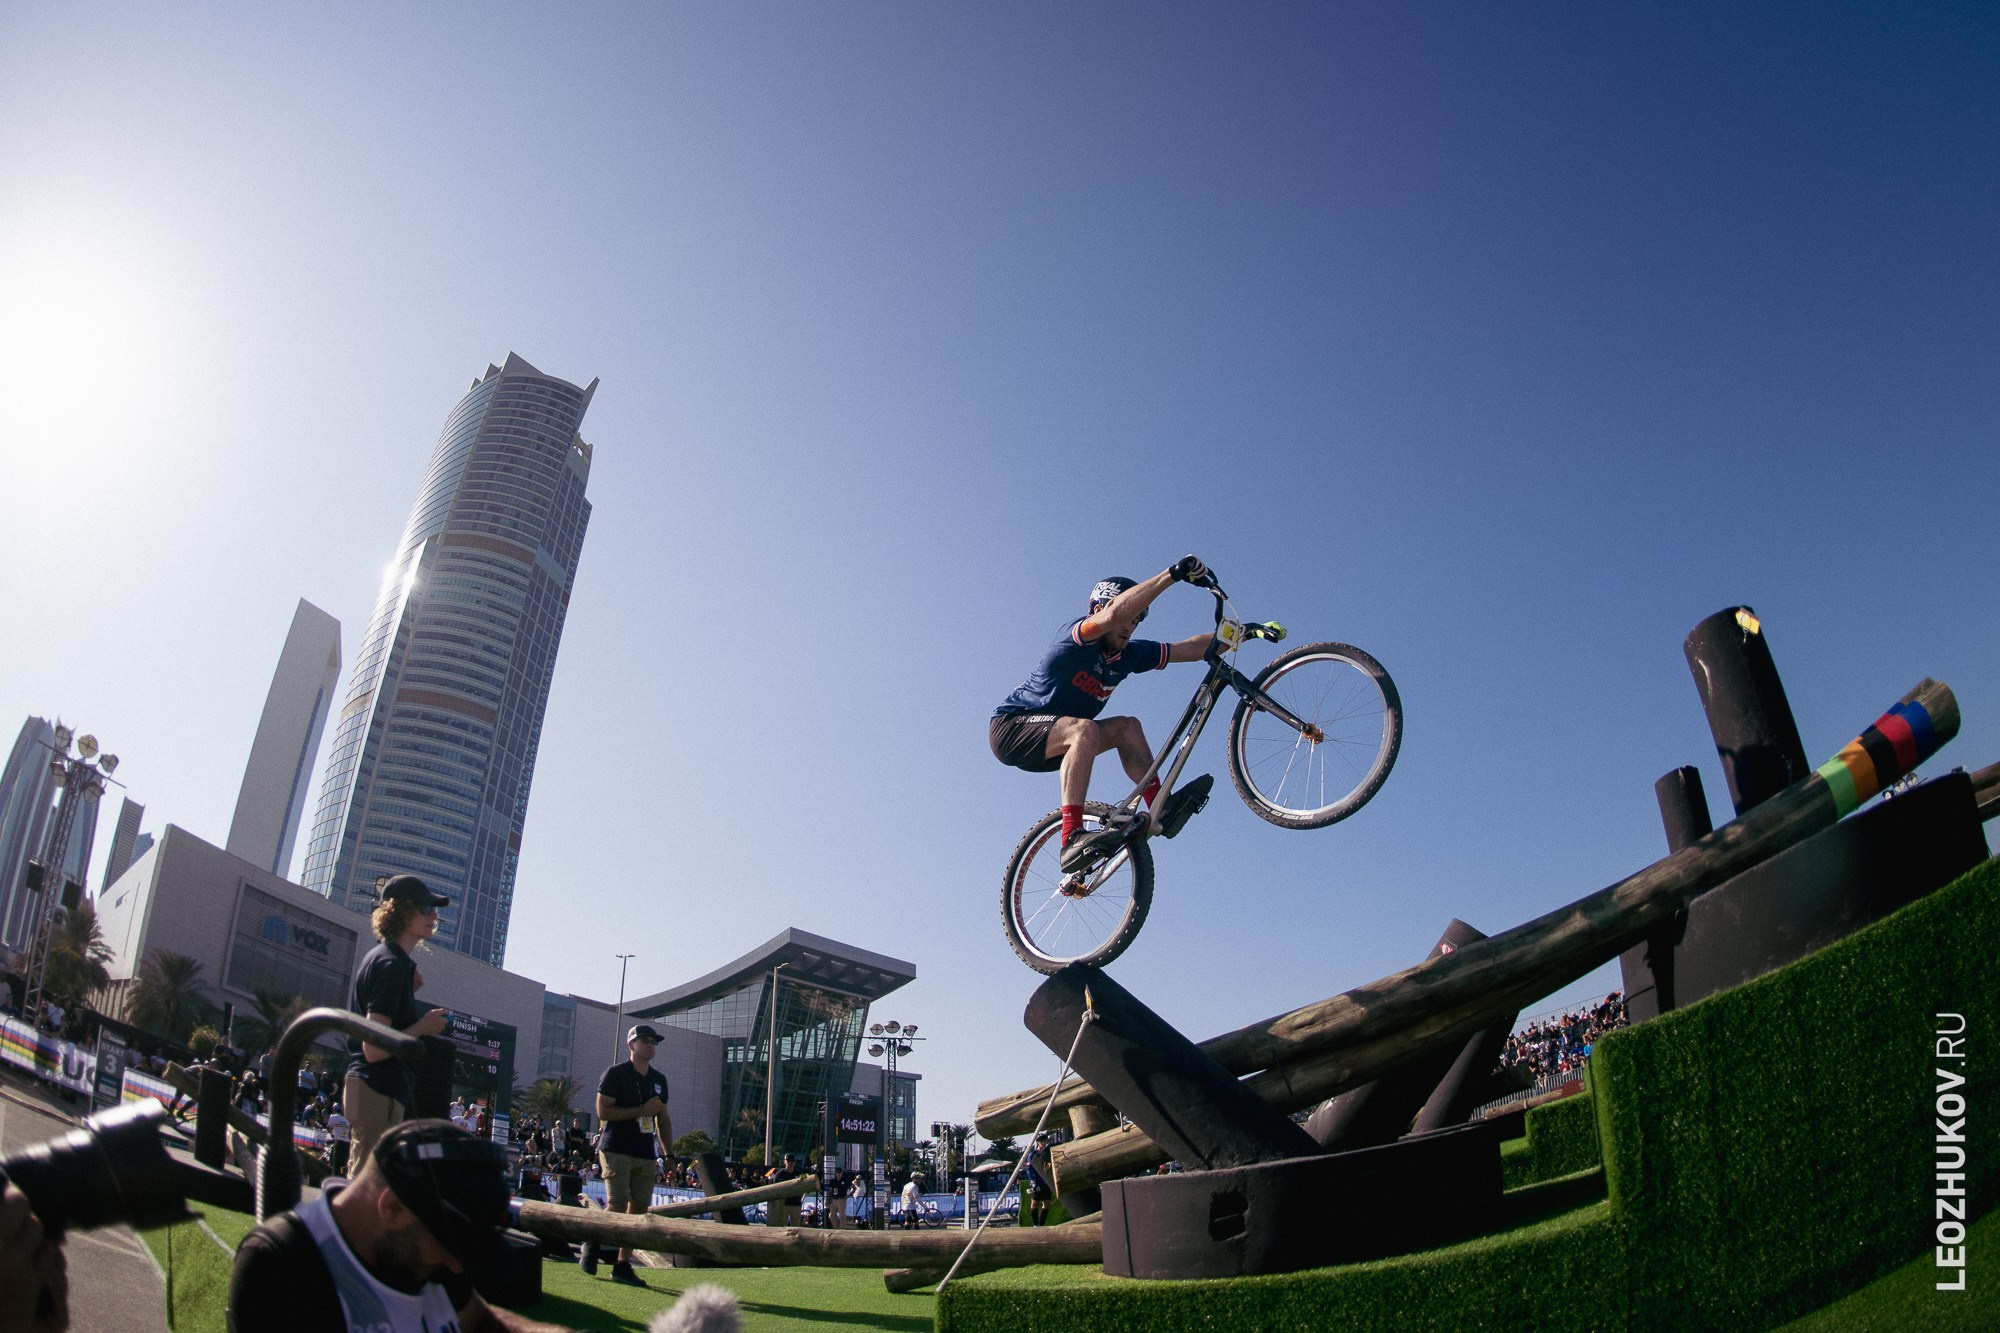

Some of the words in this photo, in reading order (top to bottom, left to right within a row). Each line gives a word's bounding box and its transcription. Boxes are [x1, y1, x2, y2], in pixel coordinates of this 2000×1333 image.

[292, 924, 331, 956] VOX
[452, 1020, 478, 1032] FINISH
[101, 1042, 125, 1057] START
[104, 1054, 117, 1074] 3
[487, 1064, 497, 1074] 10
[841, 1118, 875, 1132] 14:51:22
[971, 1191, 977, 1200] 5
